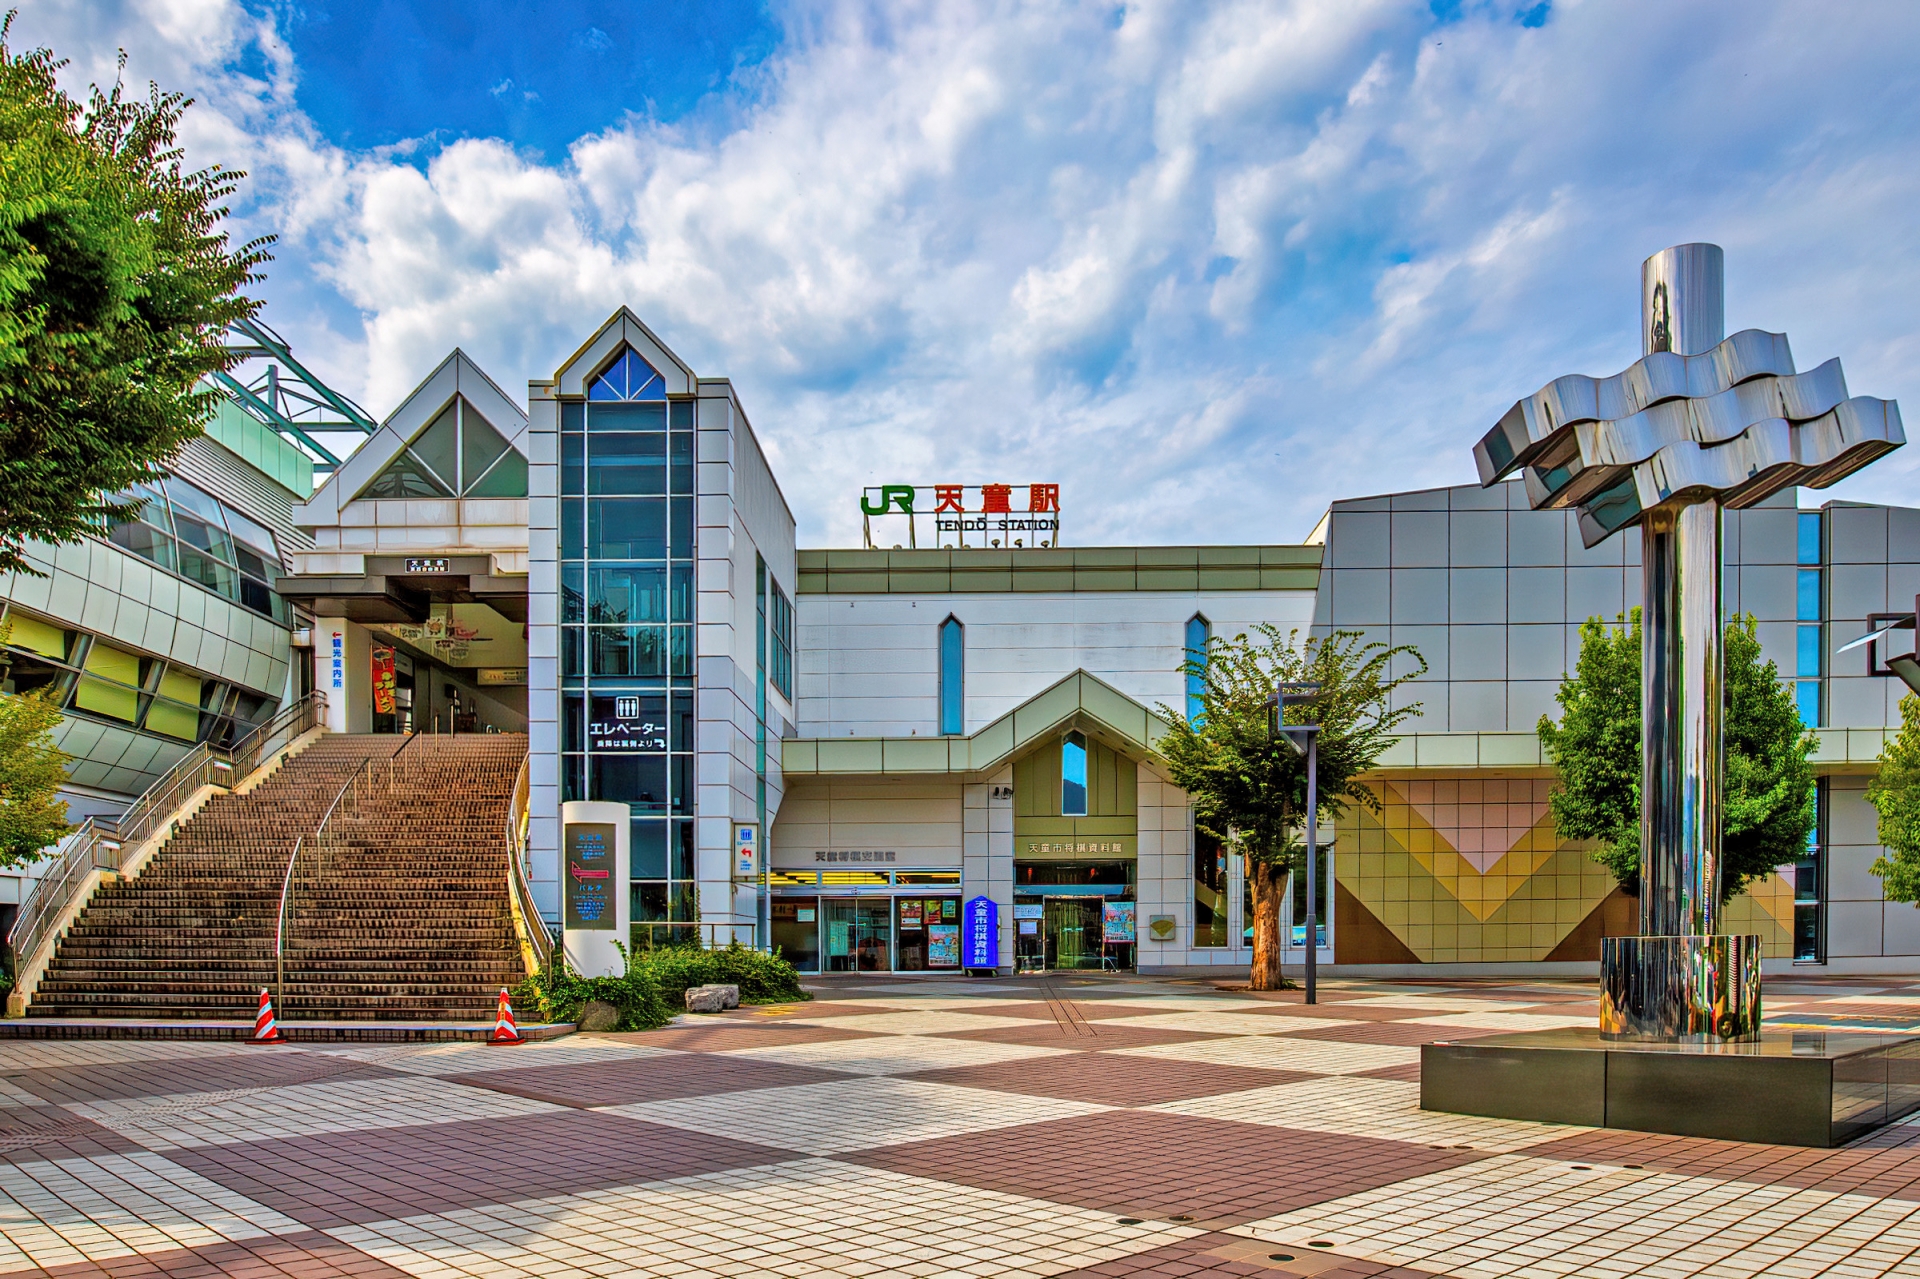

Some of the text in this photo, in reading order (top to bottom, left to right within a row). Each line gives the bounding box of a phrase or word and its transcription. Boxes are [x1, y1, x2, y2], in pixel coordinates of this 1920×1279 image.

[861, 483, 1060, 515] JR 天童駅
[998, 519, 1060, 531] STATION
[332, 638, 342, 688] 観光案内所
[589, 722, 666, 735] エレベーター
[1029, 842, 1122, 853] 天童市将棋資料館
[973, 900, 988, 965] 天童市将棋資料館
